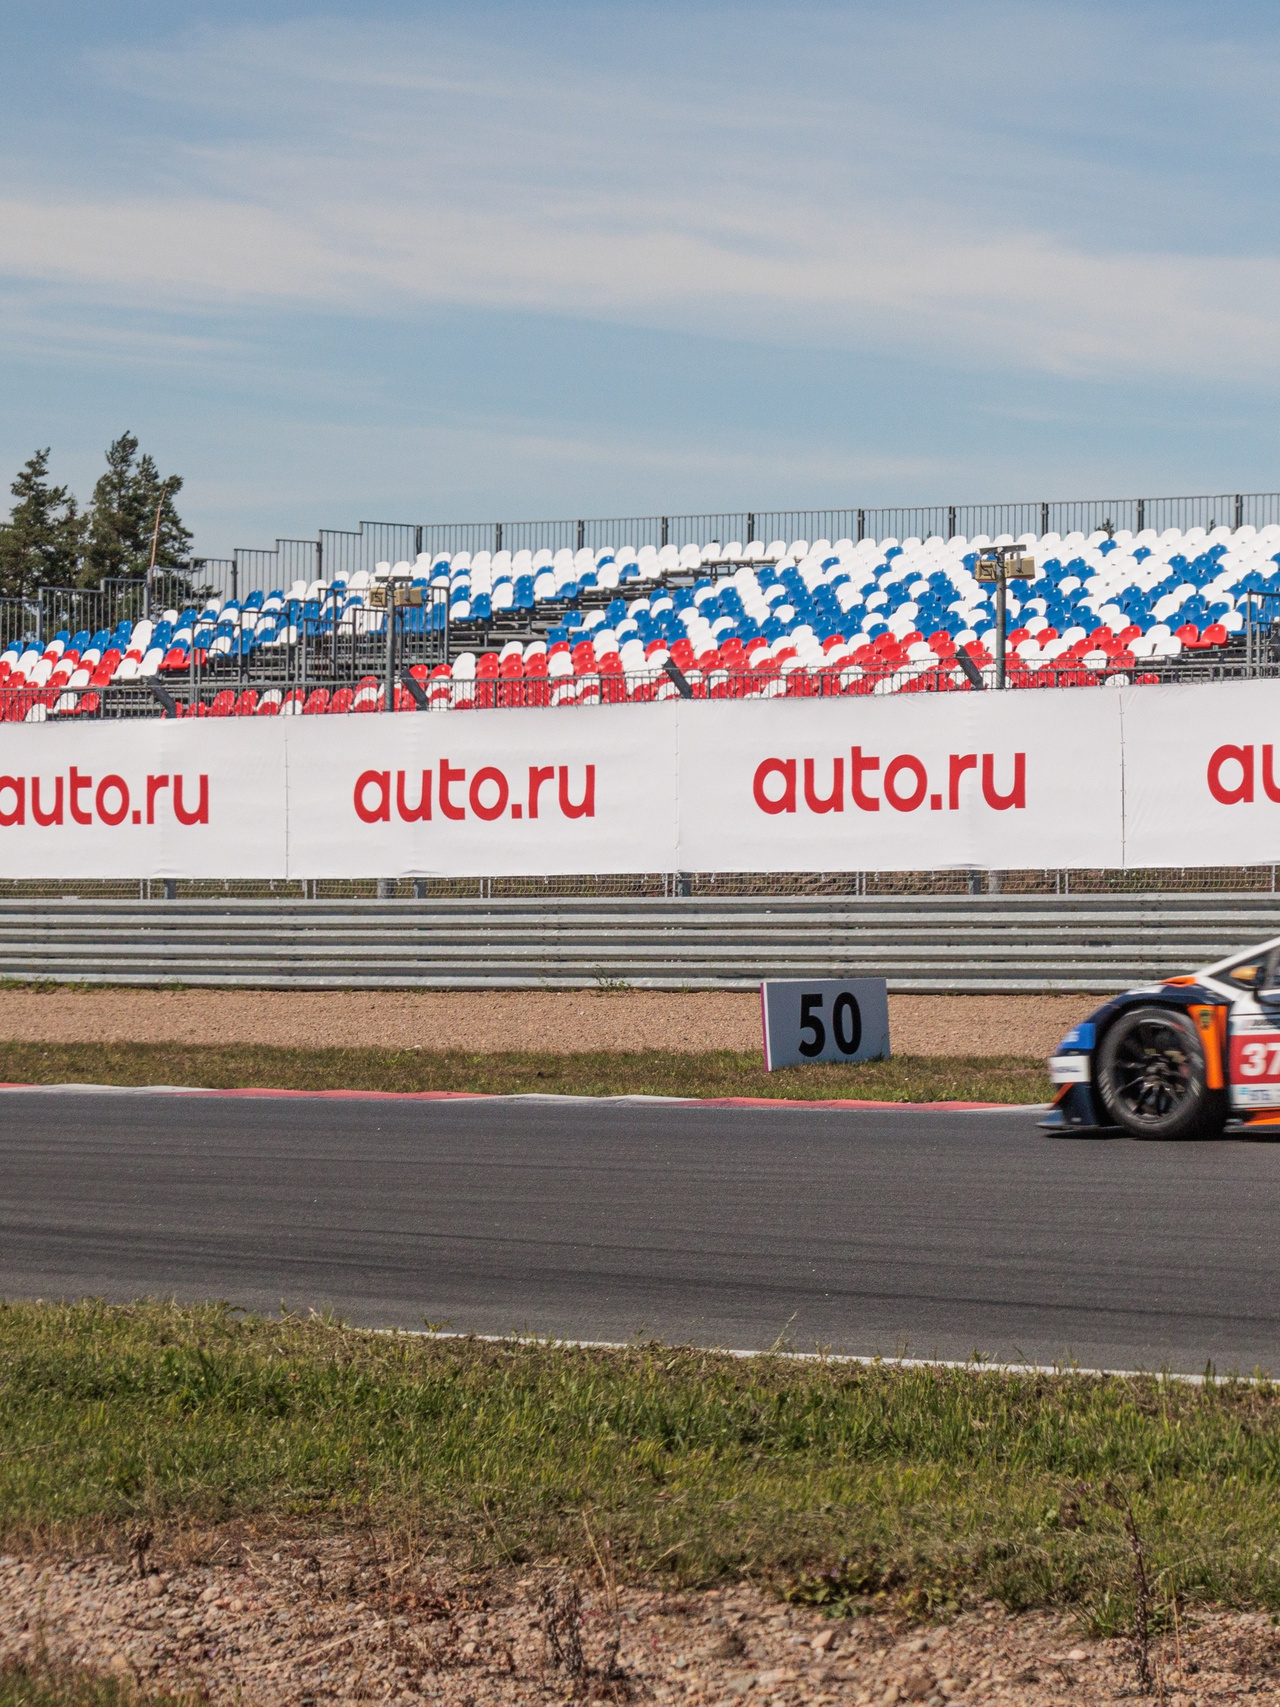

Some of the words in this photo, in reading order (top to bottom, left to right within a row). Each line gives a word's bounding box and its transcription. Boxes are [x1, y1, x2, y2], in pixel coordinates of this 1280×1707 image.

[353, 758, 595, 824] auto.ru
[753, 746, 1026, 815] auto.ru
[798, 992, 862, 1058] 50
